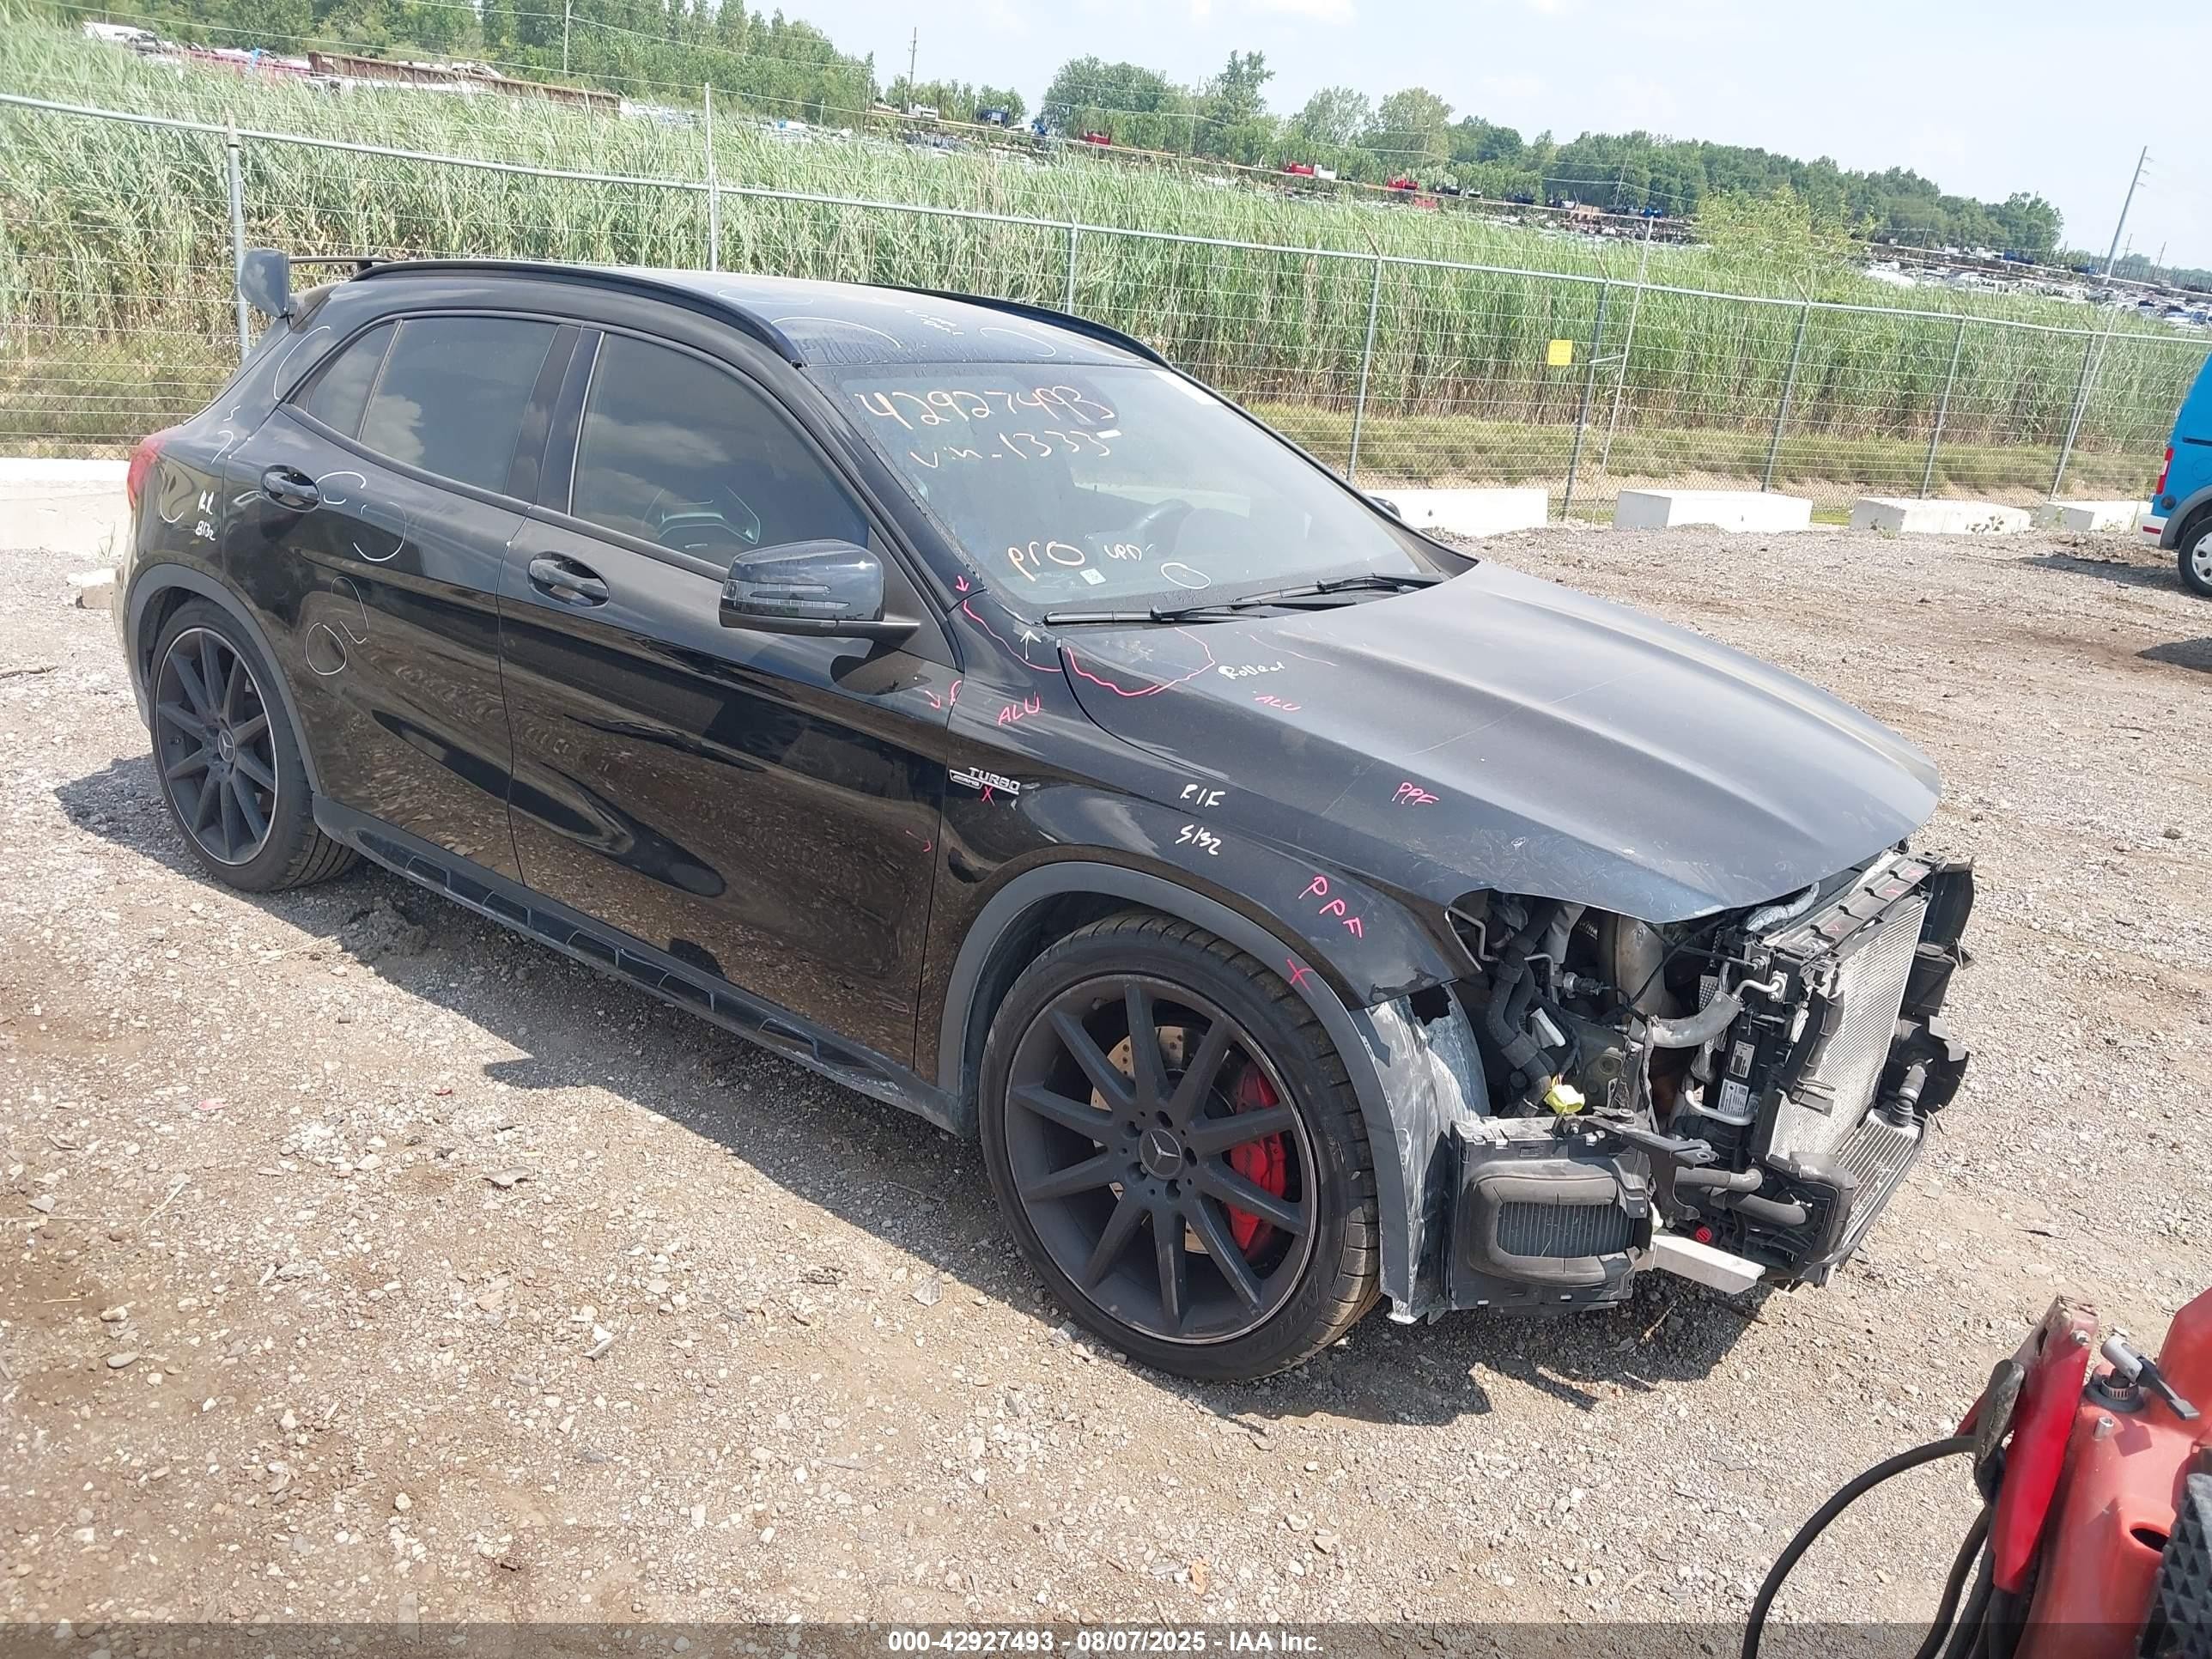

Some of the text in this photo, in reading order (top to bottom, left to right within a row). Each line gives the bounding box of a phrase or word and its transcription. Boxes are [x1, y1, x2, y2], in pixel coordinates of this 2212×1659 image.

[854, 386, 1115, 430] 42927493
[998, 690, 1040, 726] ALU
[1255, 695, 1302, 711] ALU
[969, 767, 1021, 791] TURBO
[1391, 781, 1440, 805] PPF
[1297, 876, 1363, 939] PPF
